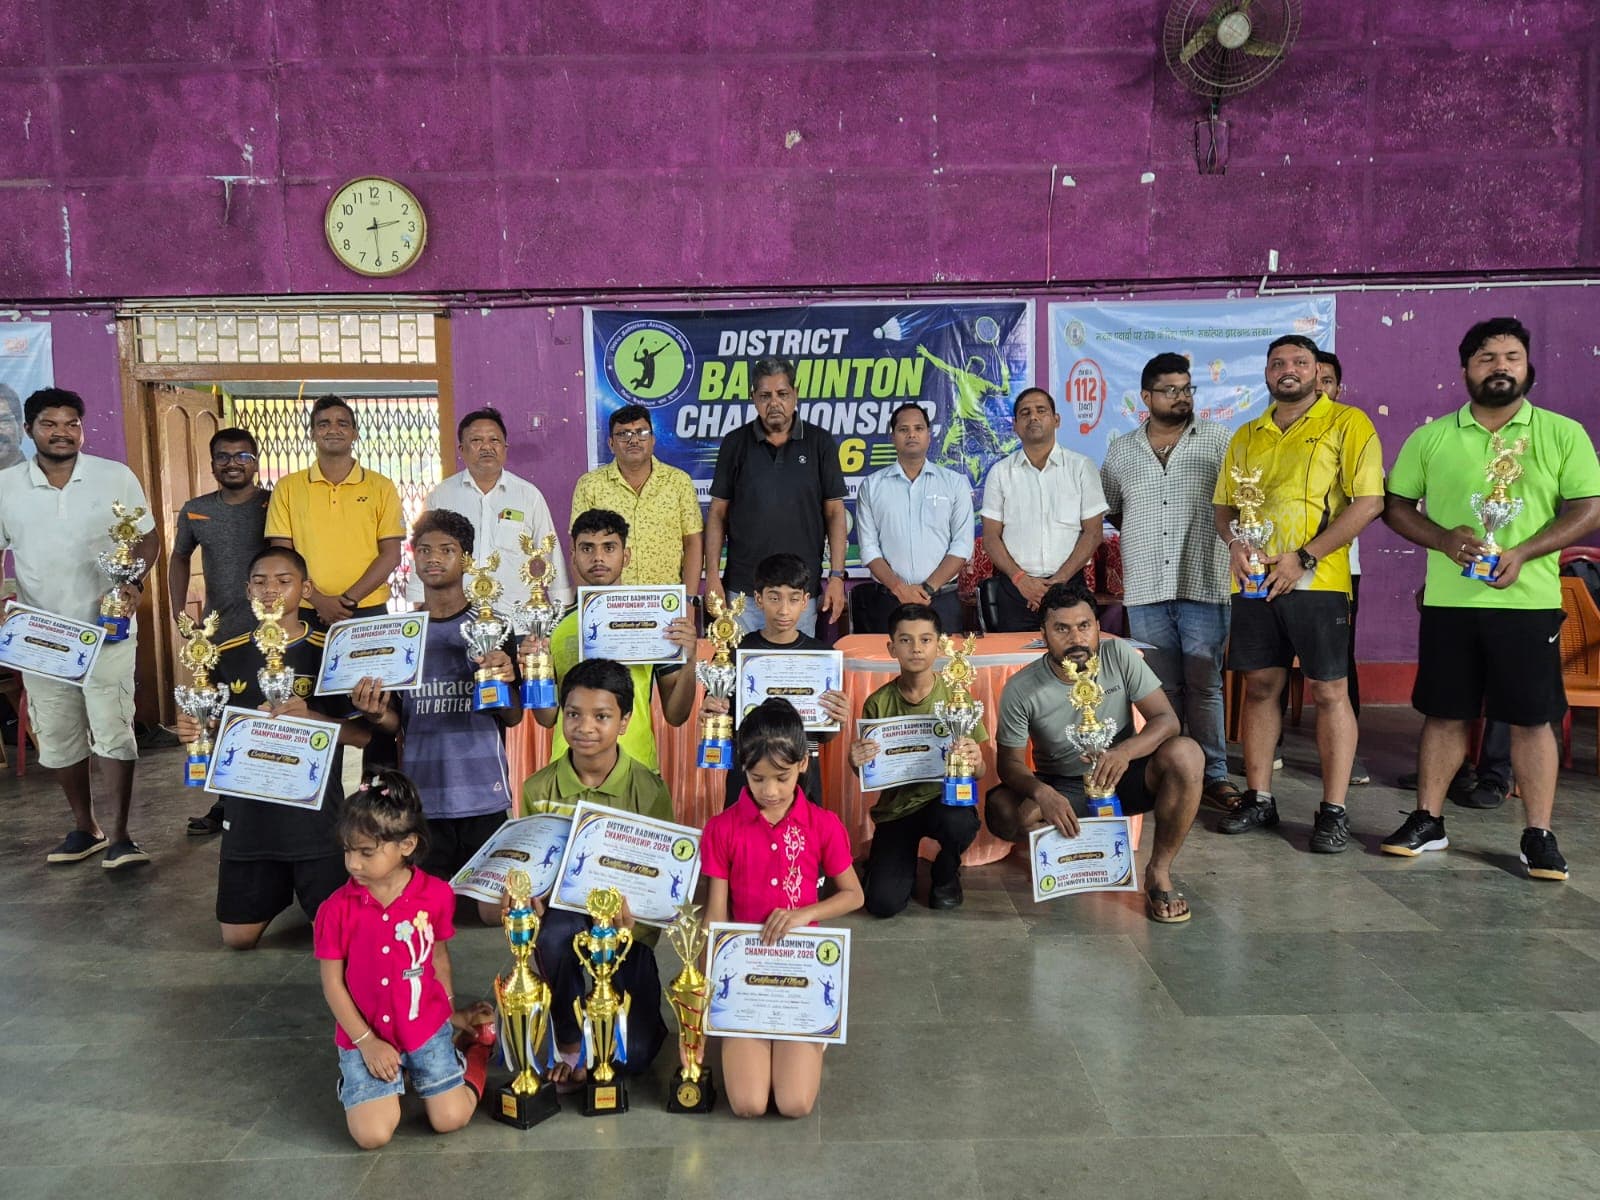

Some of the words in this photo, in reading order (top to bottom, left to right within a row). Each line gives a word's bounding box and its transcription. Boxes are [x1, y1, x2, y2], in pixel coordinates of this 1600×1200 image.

[352, 192, 362, 204] 11
[369, 186, 380, 198] 12
[342, 204, 353, 216] 10
[401, 204, 409, 215] 2
[336, 222, 344, 232] 9
[408, 221, 415, 232] 3
[343, 239, 351, 250] 8
[404, 240, 410, 249] 4
[359, 252, 366, 263] 7
[375, 256, 382, 267] 6
[392, 251, 399, 262] 5
[718, 328, 848, 356] DISTRICT
[1074, 378, 1097, 402] 112
[30, 615, 52, 625] DISTRICT
[53, 621, 81, 633] BADMINTON
[352, 625, 372, 633] DISTRICT
[409, 678, 474, 698] mirate
[416, 699, 431, 714] FLY
[434, 698, 471, 713] BETTER
[253, 721, 276, 730] DISTRICT
[279, 725, 310, 736] BADMINTON
[251, 729, 292, 742] CHAMPIONSHIP,
[607, 821, 634, 833] DISTRICT
[635, 828, 672, 843] BADMINTON
[604, 830, 652, 849] CHAMPIONSHIP,
[653, 842, 670, 852] 2026
[776, 938, 815, 949] BADMINTON
[745, 947, 796, 958] CHAMPIONSHIP,
[797, 950, 814, 959] 2026
